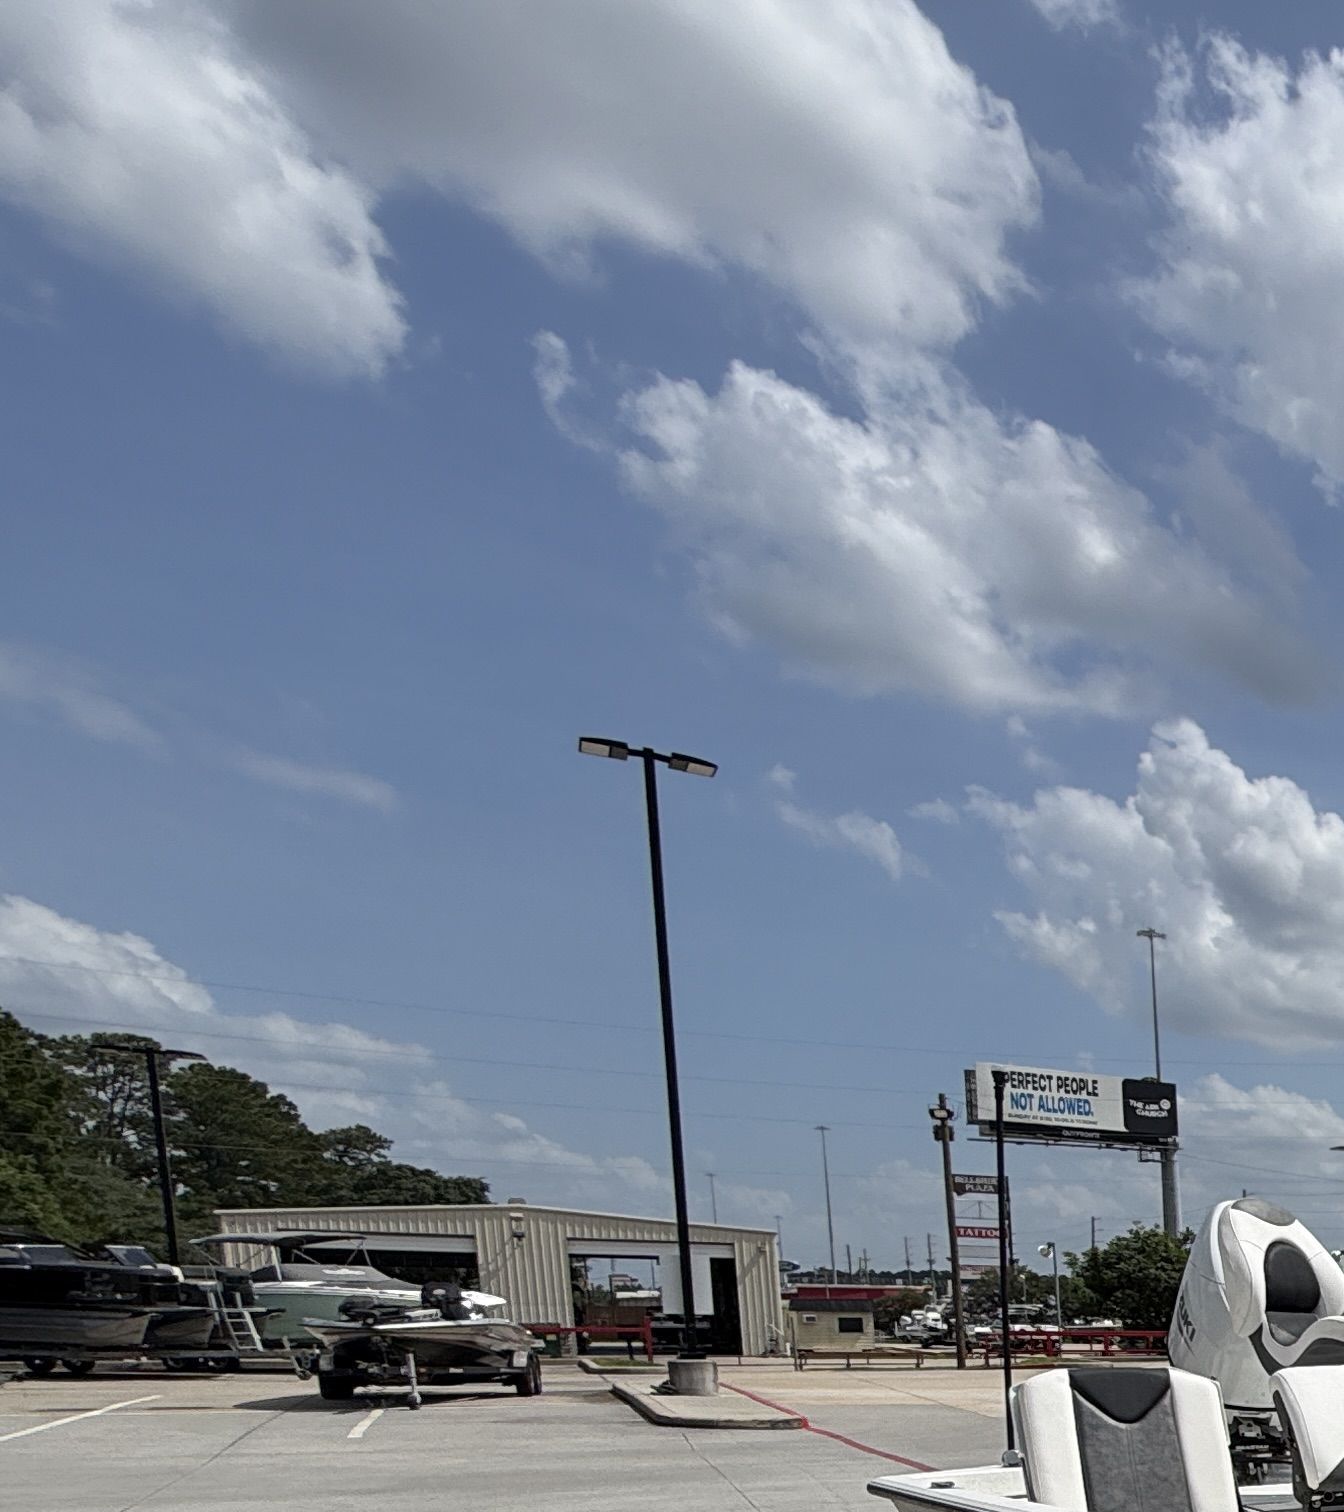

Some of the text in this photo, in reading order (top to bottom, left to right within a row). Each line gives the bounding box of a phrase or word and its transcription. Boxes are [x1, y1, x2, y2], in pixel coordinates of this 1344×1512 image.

[1004, 1071, 1099, 1097] PERFECT PEOPLE
[1010, 1092, 1094, 1117] NOT ALLOWED.
